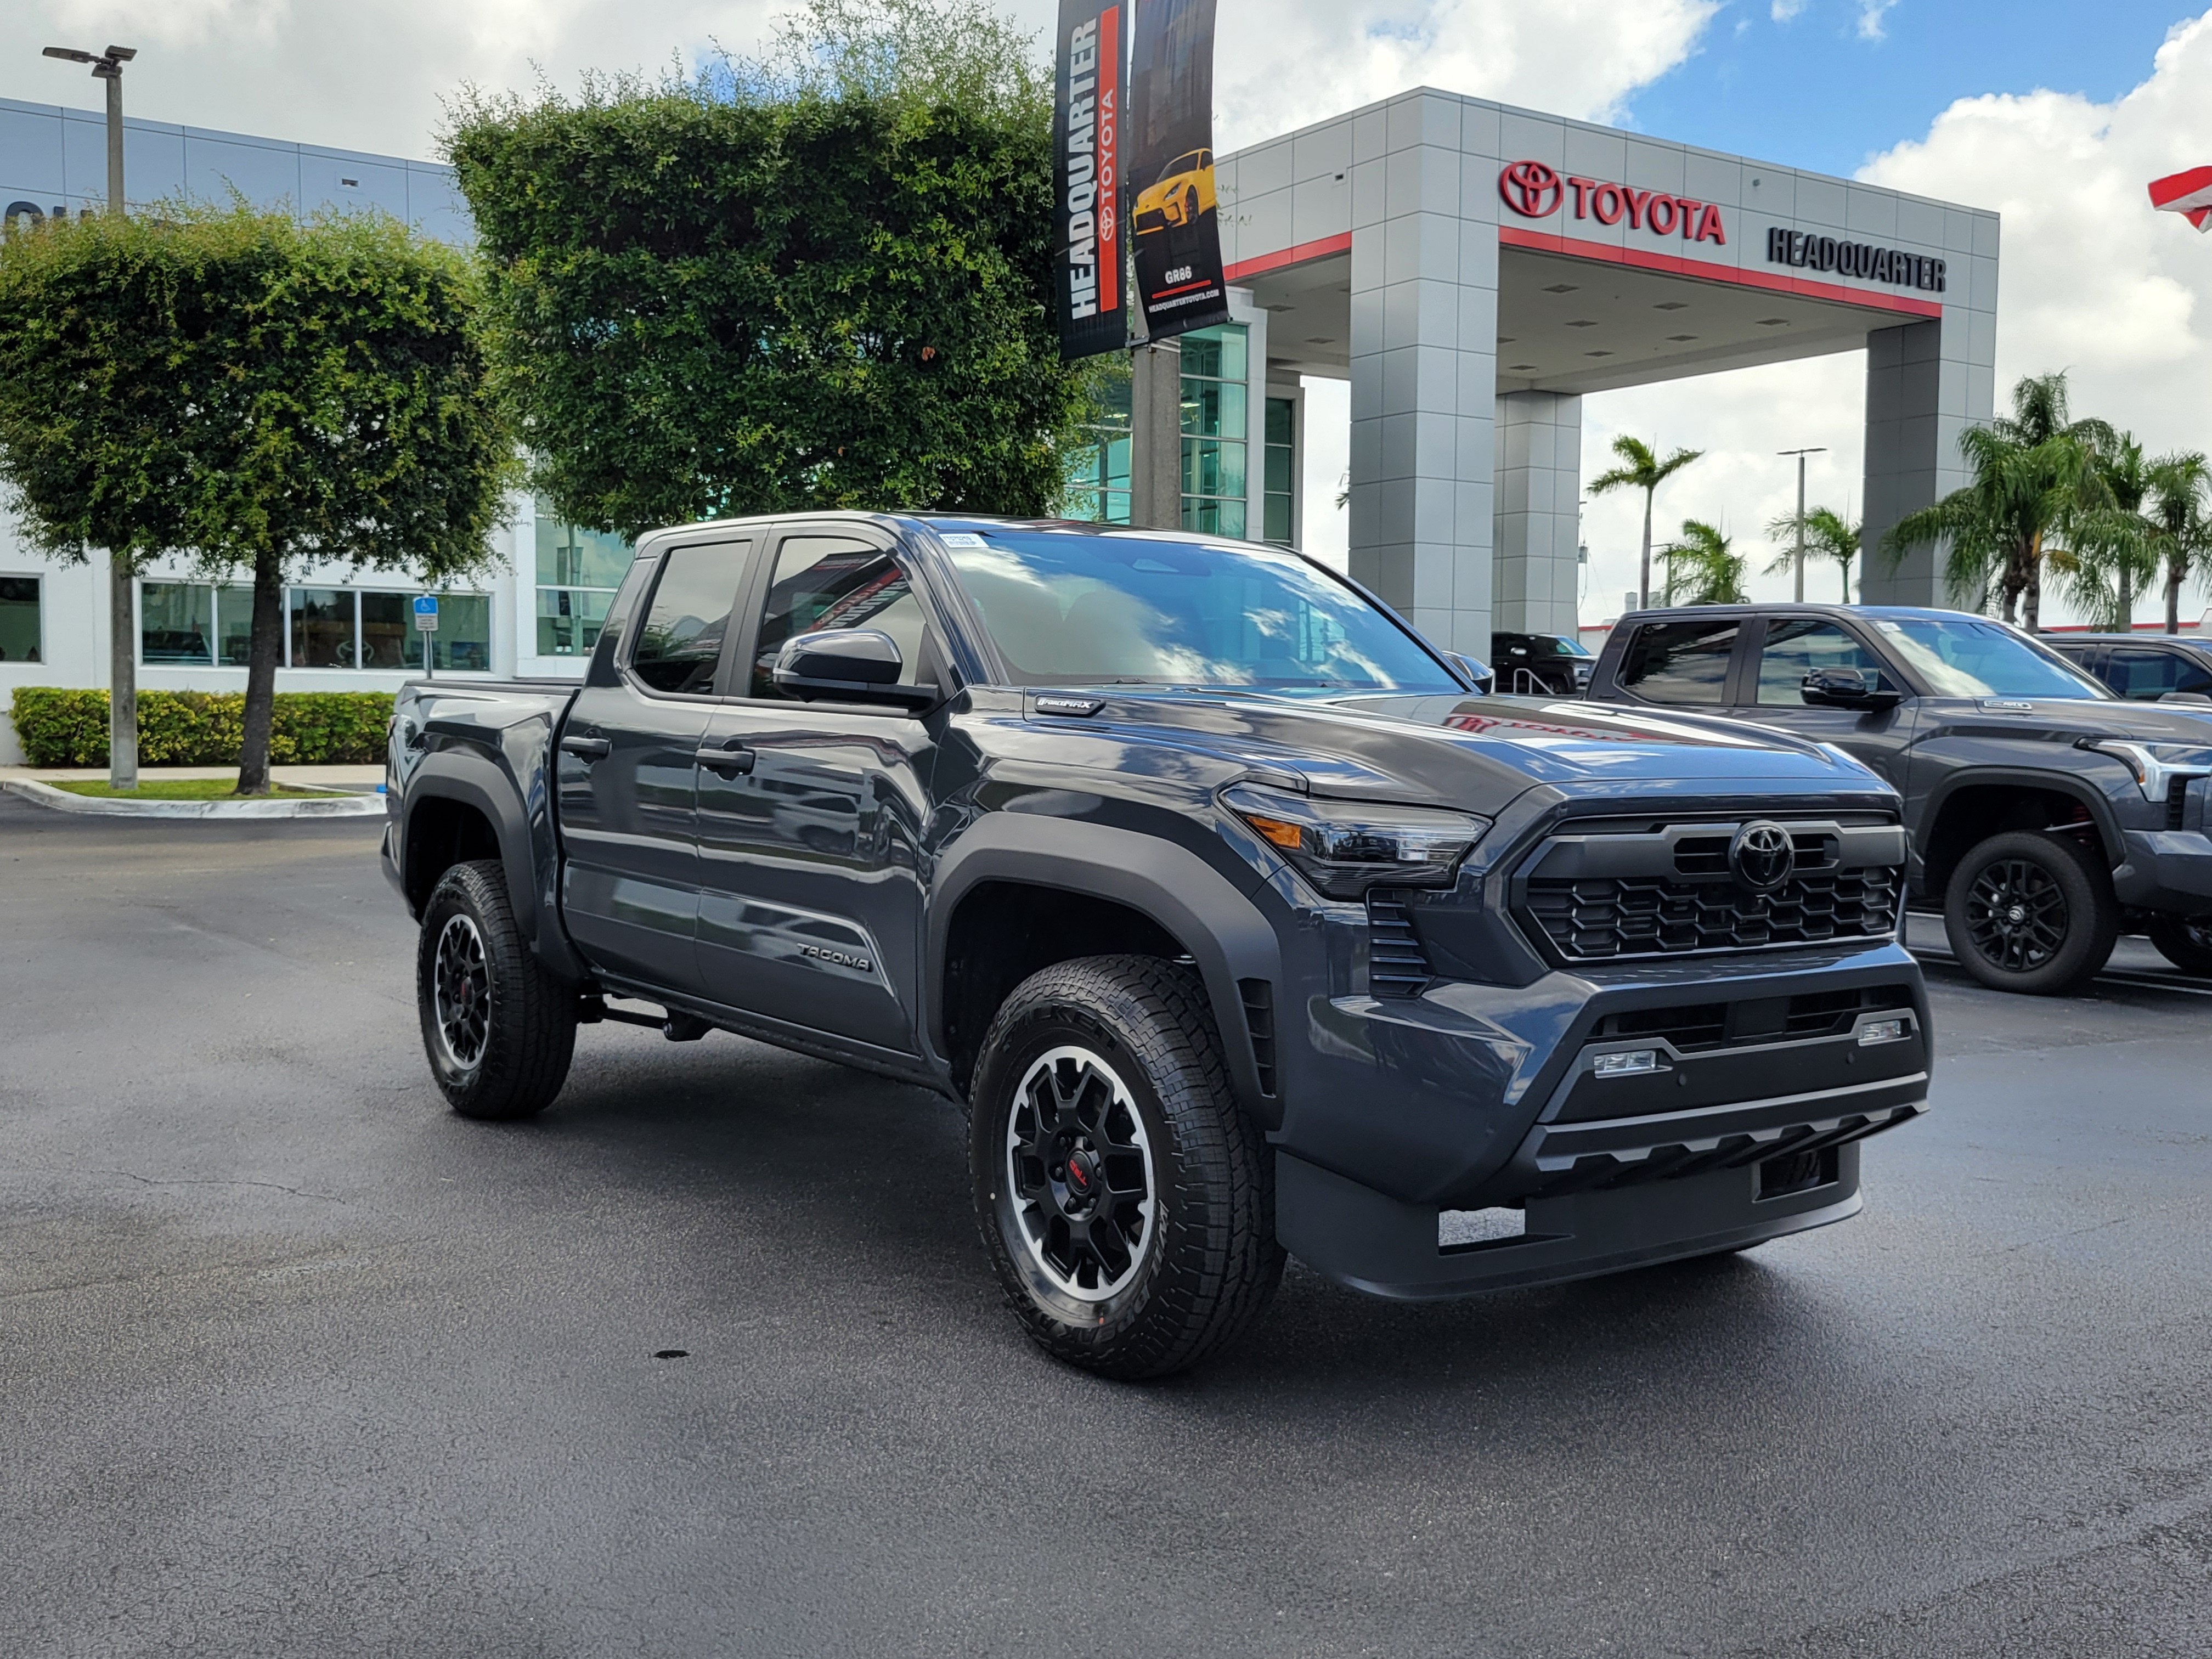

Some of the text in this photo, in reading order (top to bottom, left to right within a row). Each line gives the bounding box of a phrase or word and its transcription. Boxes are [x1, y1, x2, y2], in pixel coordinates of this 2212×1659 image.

[1068, 18, 1097, 320] HEADQUARTER
[1101, 88, 1114, 204] TOYOTA
[1567, 177, 1726, 245] TOYOTA
[1165, 266, 1192, 284] GR86
[1768, 227, 1946, 292] HEADQUARTER
[1148, 289, 1220, 313] HEADQUARTERTOYOTA.COM
[797, 943, 870, 972] TACOMA
